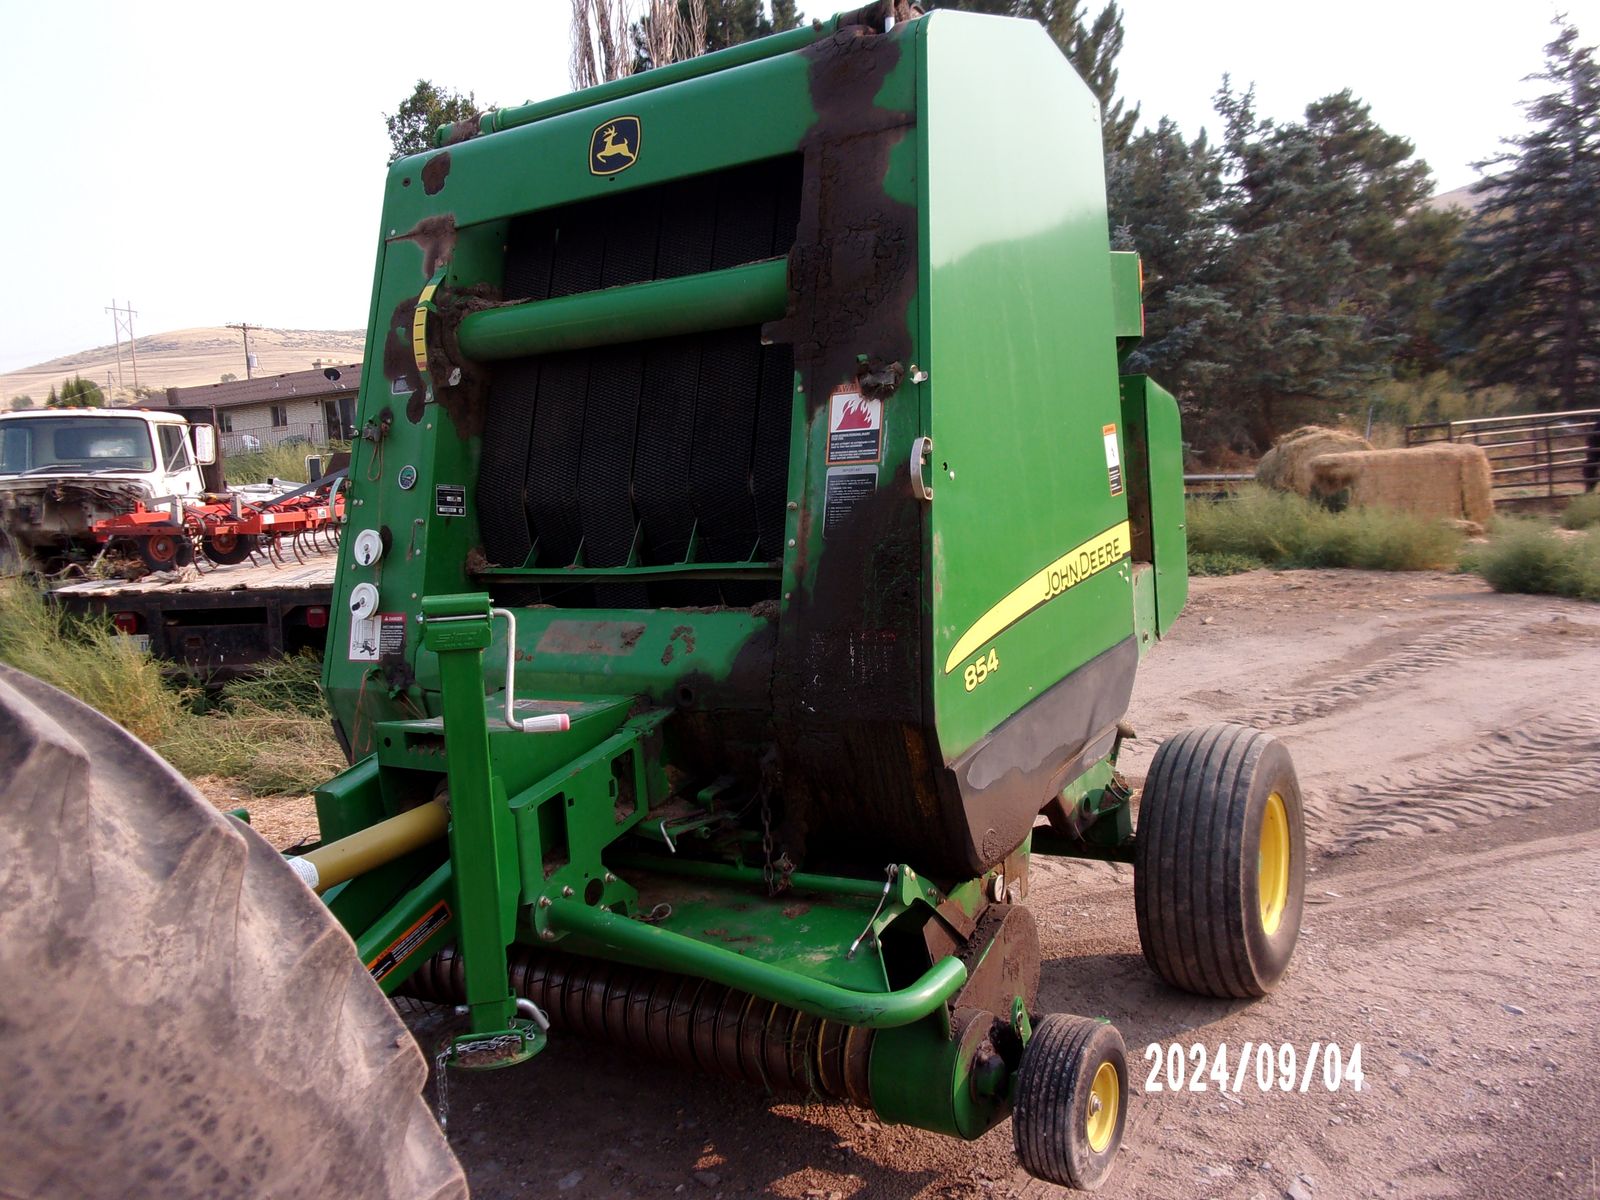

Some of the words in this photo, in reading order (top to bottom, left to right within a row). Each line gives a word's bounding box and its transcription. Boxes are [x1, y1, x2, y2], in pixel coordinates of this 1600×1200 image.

[1044, 560, 1079, 597] JOHN
[1079, 538, 1121, 576] DEERE
[964, 647, 999, 692] 854
